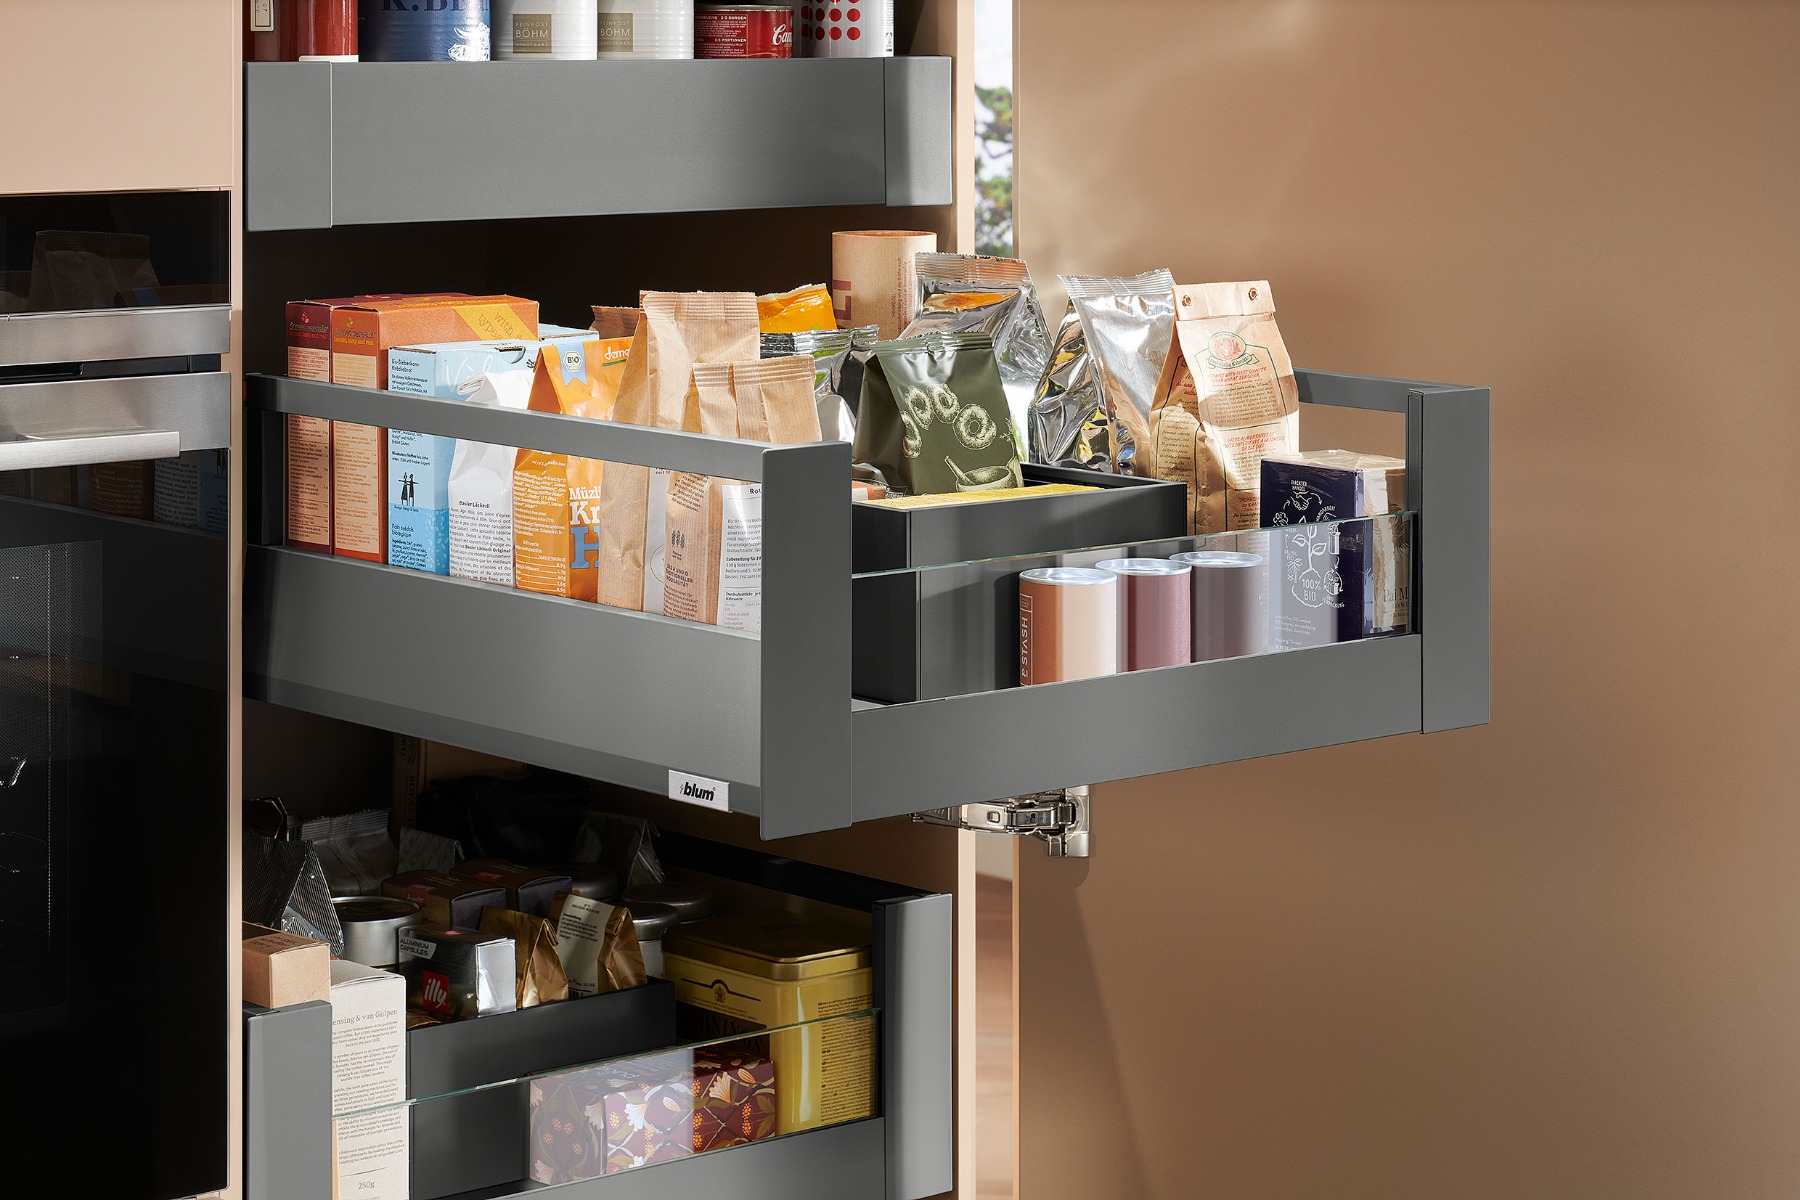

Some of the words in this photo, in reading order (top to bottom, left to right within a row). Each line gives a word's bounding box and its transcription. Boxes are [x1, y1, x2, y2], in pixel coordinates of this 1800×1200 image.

[515, 28, 548, 38] BÖHM
[600, 27, 630, 36] BÖHM
[494, 311, 514, 338] with
[569, 486, 600, 500] Müzli
[570, 500, 600, 524] Kr
[1302, 578, 1322, 590] 100%
[1304, 590, 1316, 602] BIO
[1383, 589, 1396, 602] Pai
[683, 782, 714, 802] blum
[400, 938, 430, 950] ALUMINIUM
[400, 944, 428, 956] CAPSULES
[424, 978, 448, 1009] illy
[332, 1016, 355, 1026] ensing
[374, 1009, 398, 1018] Gülpen
[358, 1181, 375, 1190] 250g
